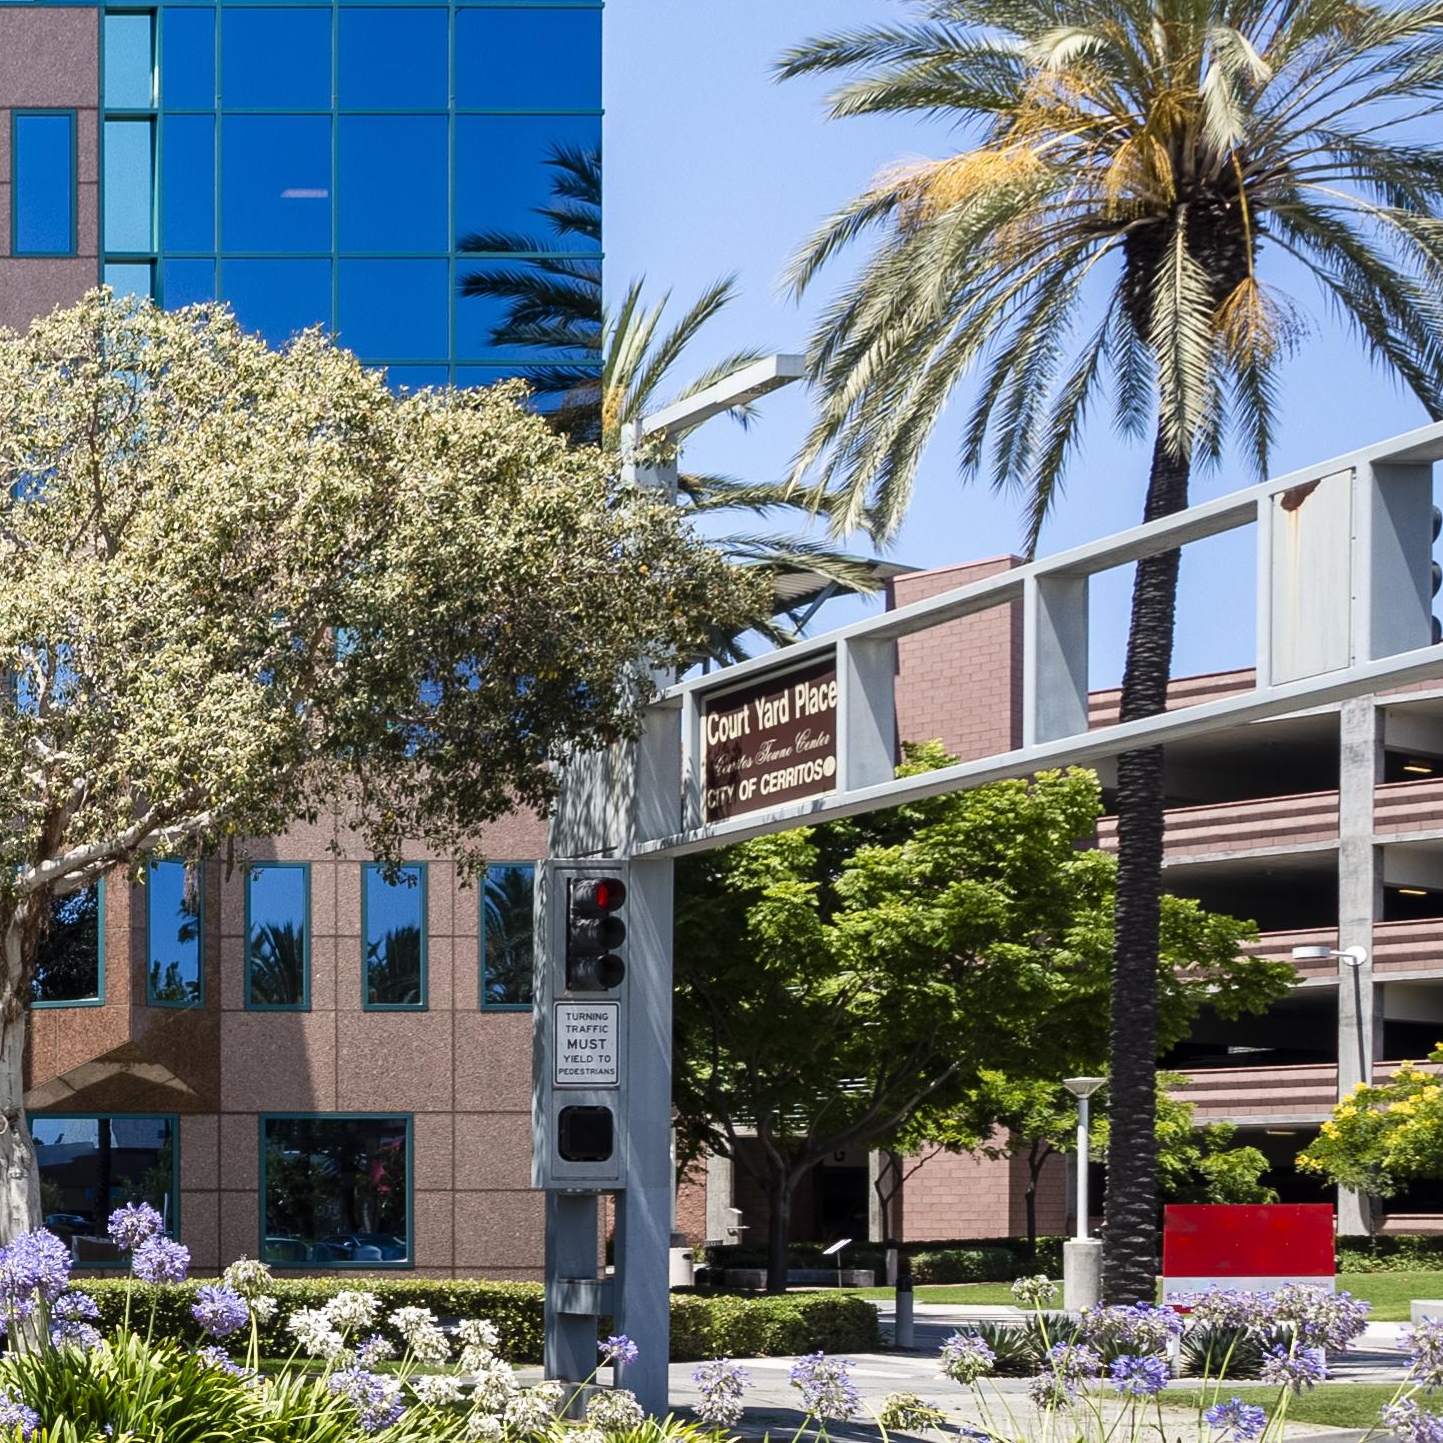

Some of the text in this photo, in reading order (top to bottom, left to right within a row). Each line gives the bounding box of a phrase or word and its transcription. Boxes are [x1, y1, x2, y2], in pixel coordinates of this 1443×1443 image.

[707, 681, 838, 746] Court Yard Place
[755, 739, 793, 765] Towne
[795, 728, 830, 754] Center
[707, 758, 823, 809] CITY OF CERRITOS
[565, 1013, 609, 1021] TURNING
[565, 1025, 609, 1033] TRAFFIC
[567, 1038, 607, 1050] MUST
[563, 1055, 611, 1063] YIELD TO
